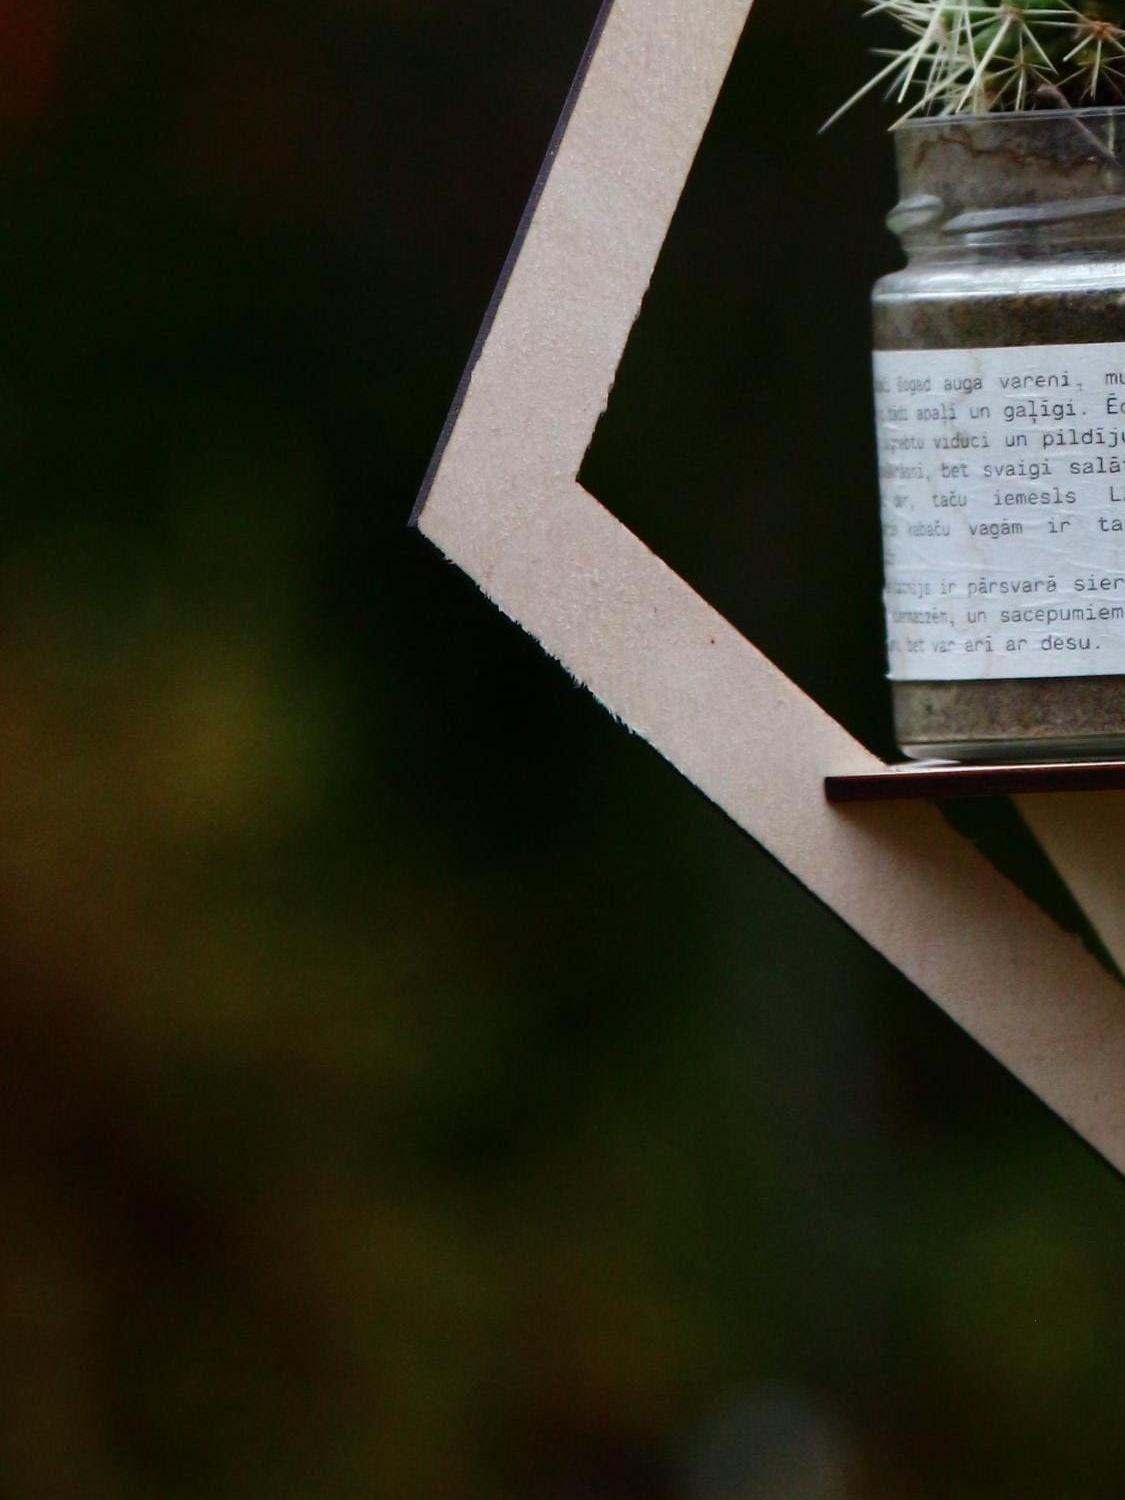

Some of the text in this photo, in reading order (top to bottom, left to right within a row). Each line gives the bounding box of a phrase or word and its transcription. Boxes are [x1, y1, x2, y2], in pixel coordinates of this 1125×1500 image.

[944, 377, 983, 394] auga
[1000, 371, 1083, 391] vareni,
[970, 406, 990, 419] un
[1003, 399, 1086, 424] gaļīgi.
[934, 432, 990, 450] viduci
[1005, 434, 1027, 447] un
[941, 463, 969, 478] bet
[983, 459, 1052, 480] svaigi
[932, 490, 967, 507] taču
[994, 488, 1076, 506] iemesls
[969, 518, 1023, 540] vagām
[1048, 517, 1071, 534] ir
[940, 578, 955, 595] ir
[968, 576, 1057, 598] pārsvarā
[967, 610, 987, 623] un
[1001, 604, 1124, 625] sacepumiem
[932, 639, 955, 653] var
[965, 635, 993, 652] arī
[1006, 639, 1027, 651] ar
[1041, 634, 1100, 651] desu.
